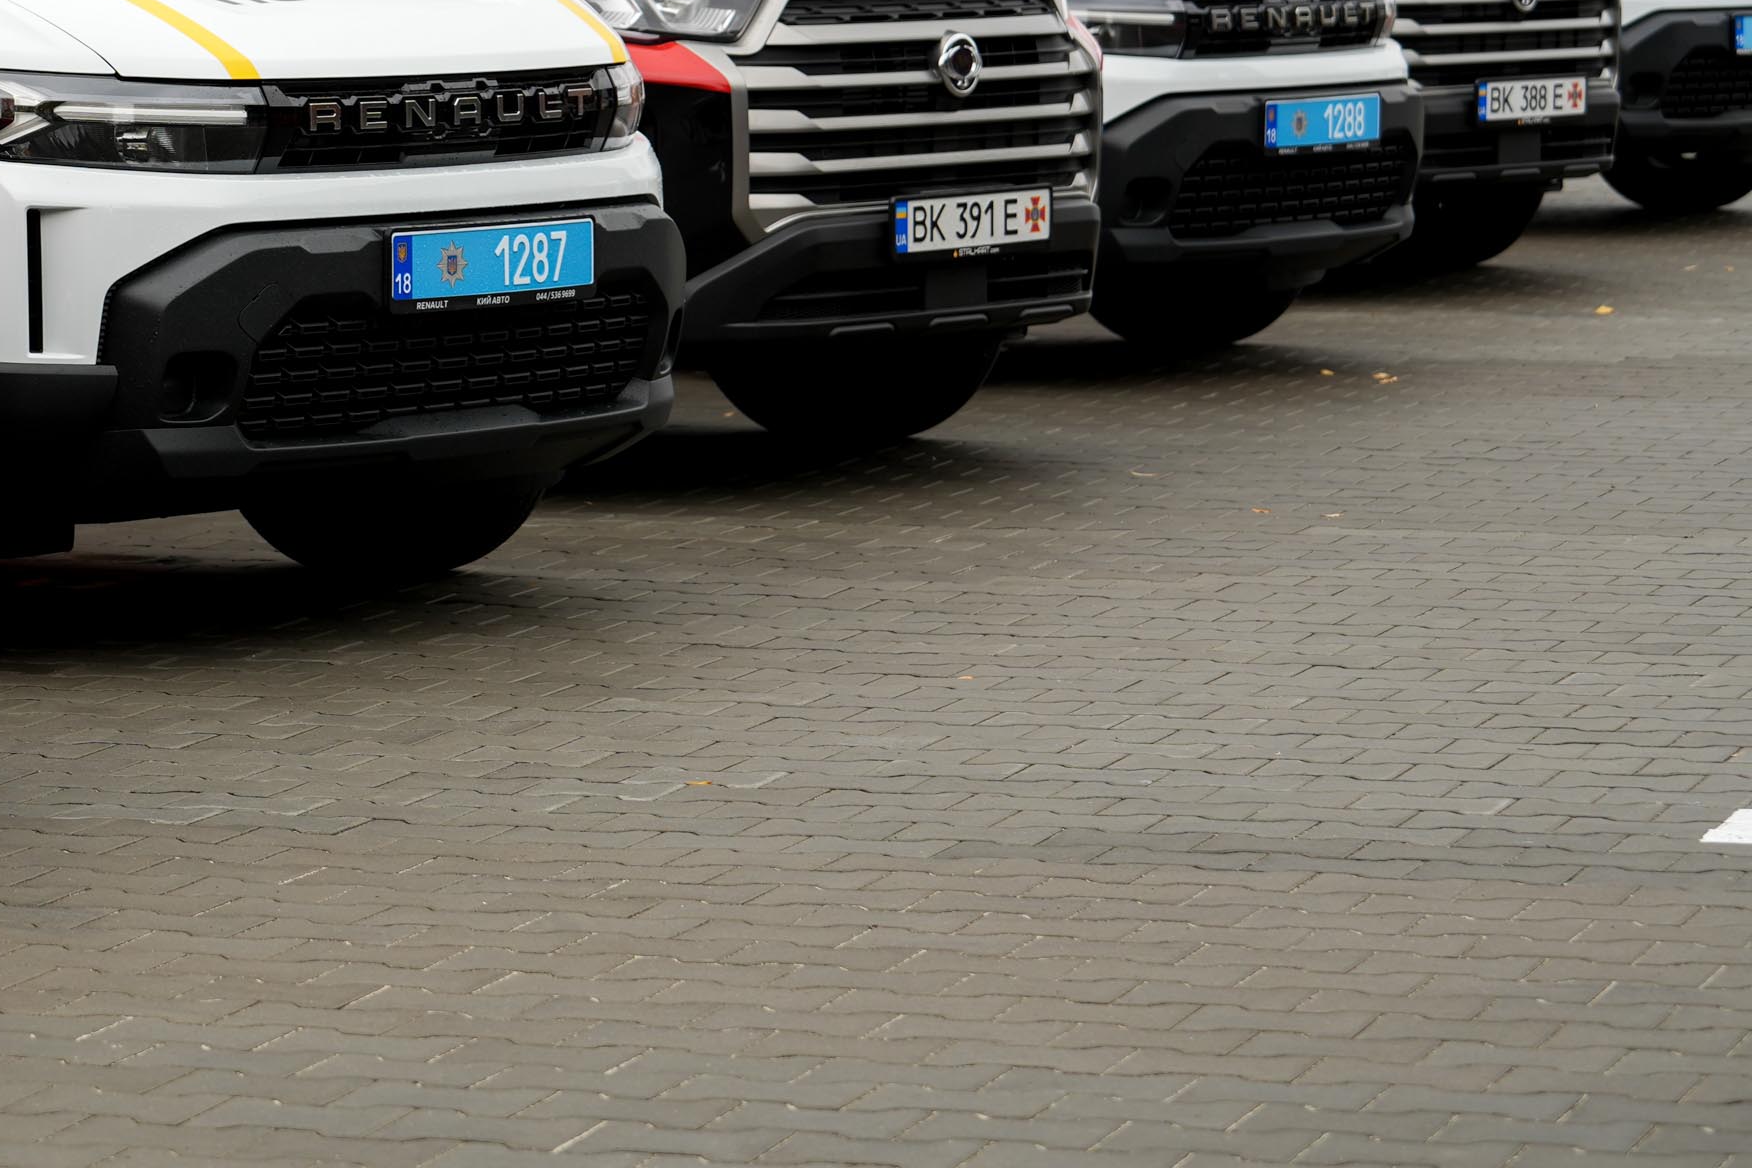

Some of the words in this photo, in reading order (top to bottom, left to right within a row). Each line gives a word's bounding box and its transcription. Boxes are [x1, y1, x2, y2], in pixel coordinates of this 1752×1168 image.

[1211, 3, 1375, 32] RENAULT
[308, 86, 593, 132] RENAULT
[1490, 85, 1514, 113] BK
[1520, 85, 1547, 112] 388
[1552, 83, 1563, 110] E
[1324, 101, 1365, 140] 1288
[1266, 128, 1277, 143] 18
[912, 203, 946, 243] BK
[955, 199, 995, 239] 391
[1003, 198, 1019, 236] E
[895, 233, 907, 247] UA
[494, 230, 568, 286] 1287
[395, 272, 412, 294] 18
[416, 299, 449, 310] RENAULT
